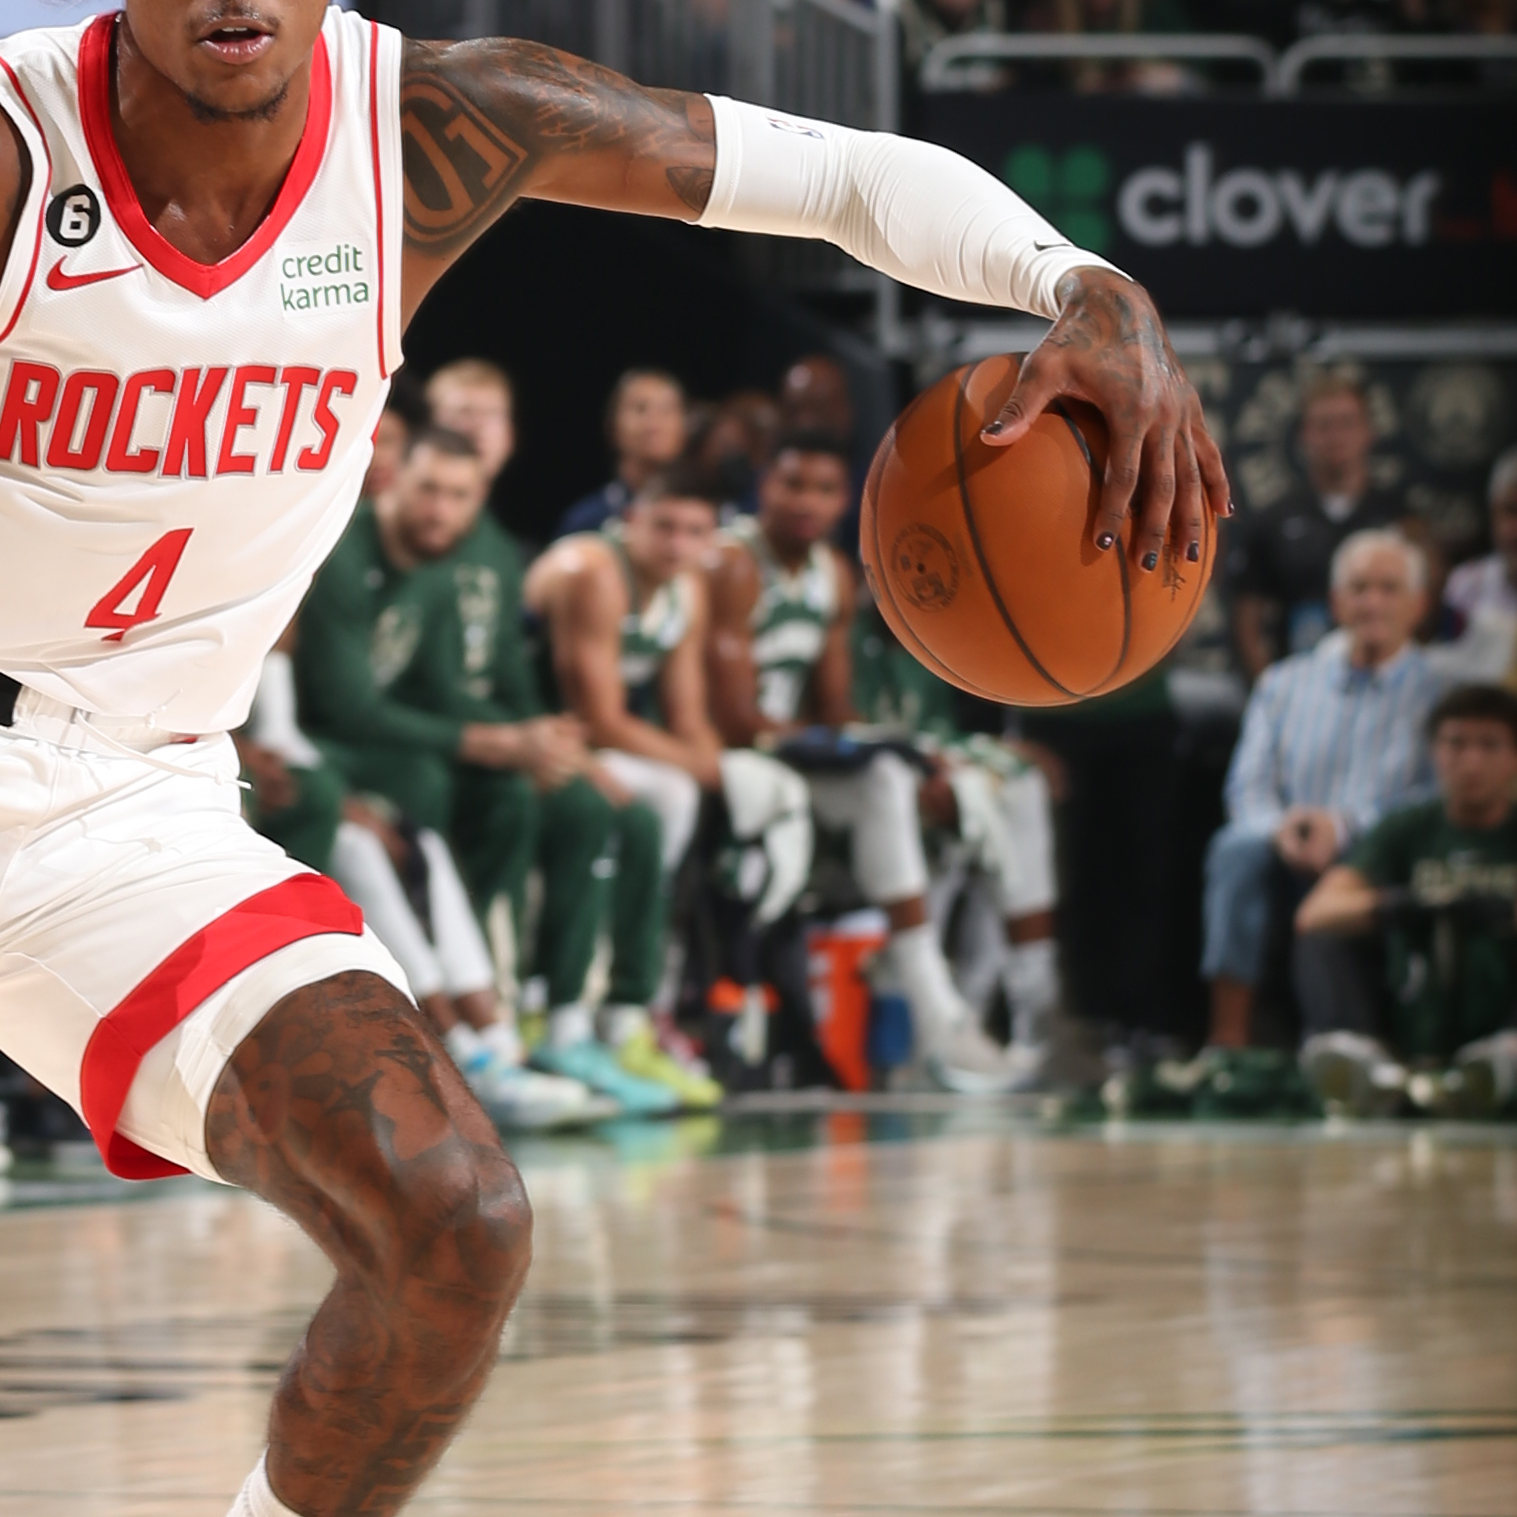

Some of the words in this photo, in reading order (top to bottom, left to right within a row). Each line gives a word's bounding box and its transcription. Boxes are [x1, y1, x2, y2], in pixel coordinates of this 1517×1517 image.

[60, 194, 92, 240] 6
[1117, 140, 1441, 249] clover
[281, 244, 363, 279] credit
[280, 281, 370, 312] karma
[84, 527, 193, 642] 4
